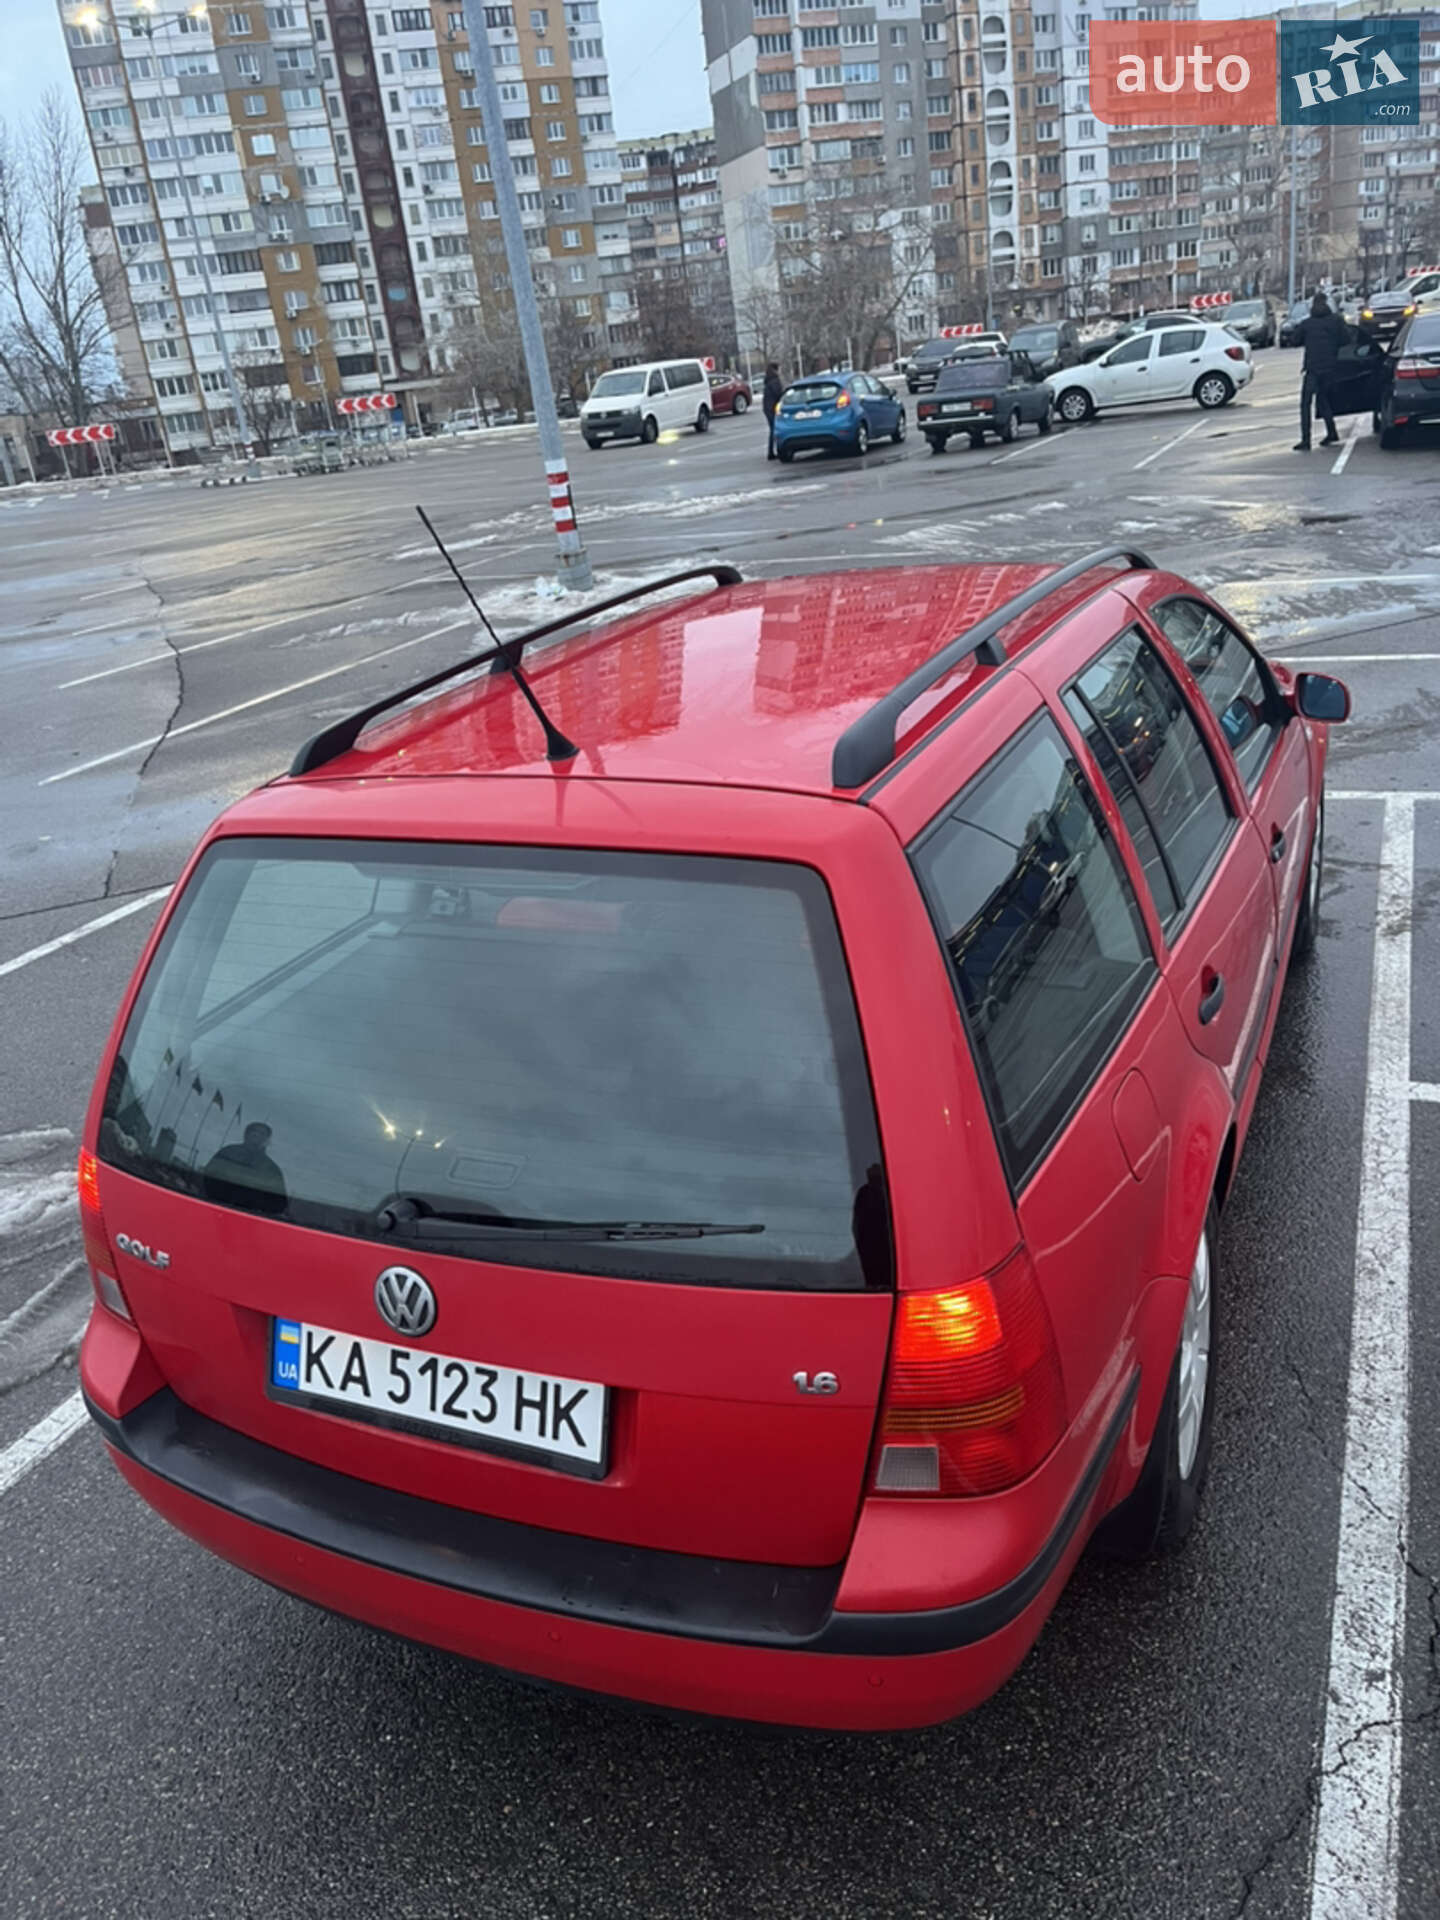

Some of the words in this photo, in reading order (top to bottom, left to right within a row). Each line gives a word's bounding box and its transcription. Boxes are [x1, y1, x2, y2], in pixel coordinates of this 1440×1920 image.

[116, 1232, 170, 1270] GOLF
[277, 1360, 298, 1380] UA
[793, 1370, 839, 1395] 1.6
[305, 1330, 371, 1398] KA
[387, 1348, 498, 1423] 5123
[514, 1375, 589, 1448] HK
